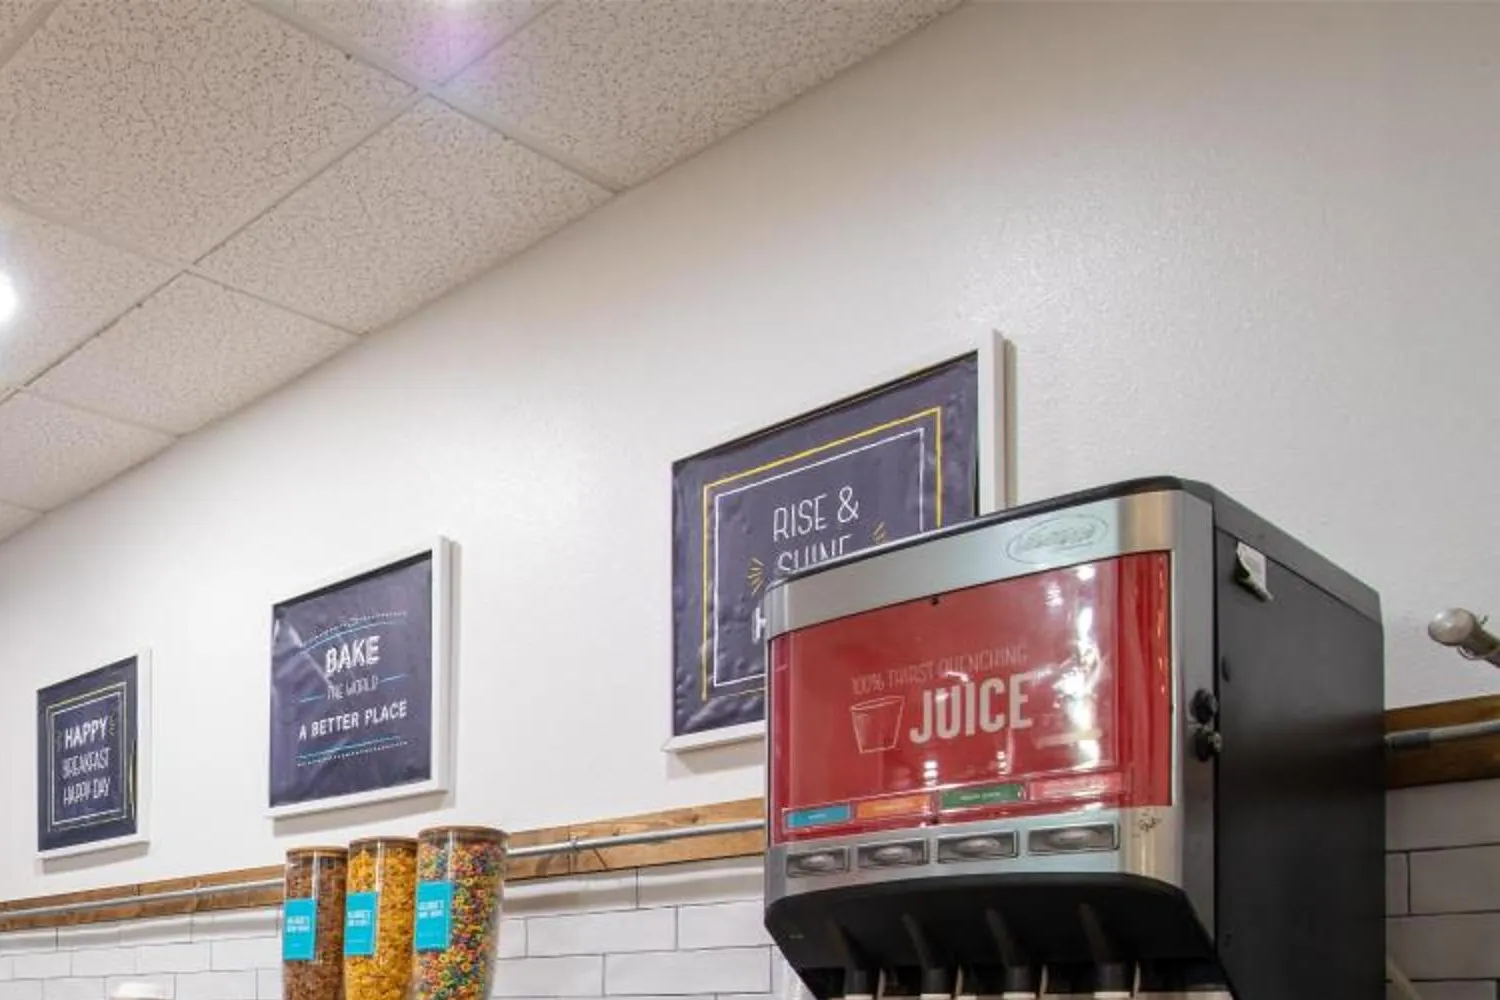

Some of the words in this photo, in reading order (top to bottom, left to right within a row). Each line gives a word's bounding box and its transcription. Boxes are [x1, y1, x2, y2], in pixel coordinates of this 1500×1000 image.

[773, 493, 828, 542] RISE
[837, 485, 860, 523] &
[325, 635, 380, 673] BAKE
[888, 660, 935, 689] THIRST
[937, 644, 1029, 677] QUENCHING
[327, 683, 344, 700] THE
[909, 673, 1034, 744] JUICE
[65, 715, 109, 750] HAPPY
[299, 724, 307, 741] A
[311, 711, 360, 738] BETTER
[365, 699, 408, 726] PLACE
[63, 781, 91, 807] HAPPY
[93, 776, 111, 799] DAY
